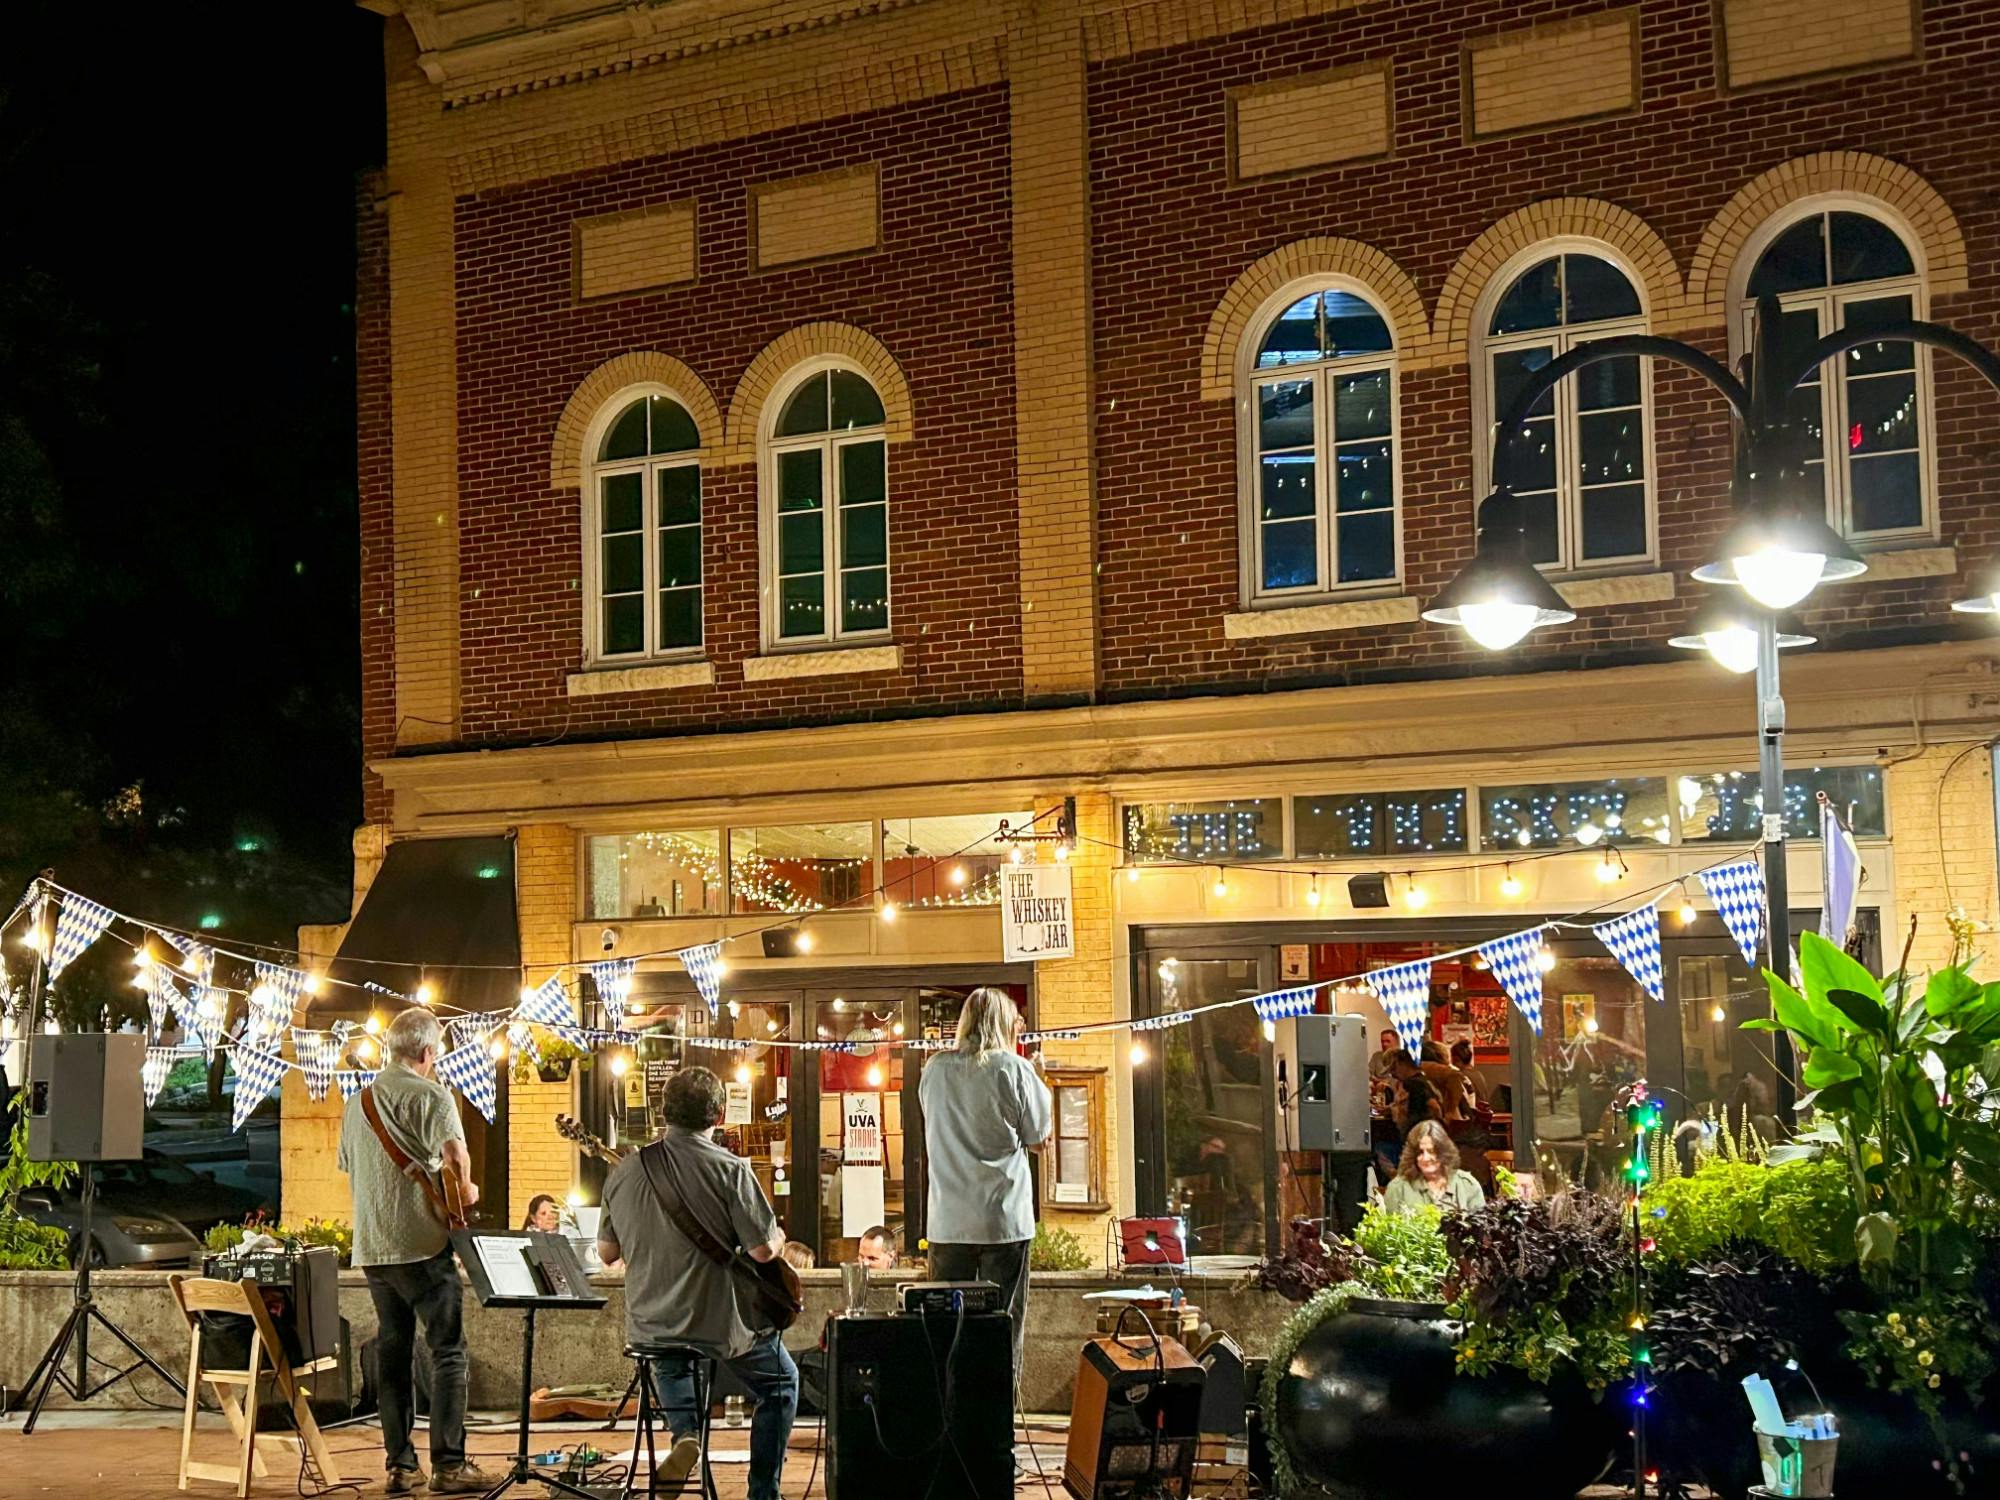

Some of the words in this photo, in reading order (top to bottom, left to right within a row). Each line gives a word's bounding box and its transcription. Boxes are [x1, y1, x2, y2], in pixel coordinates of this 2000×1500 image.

[1008, 873, 1034, 897] THE
[1011, 898, 1067, 924] WHISKEY
[1045, 924, 1068, 948] JAR
[848, 1114, 876, 1128] UVA
